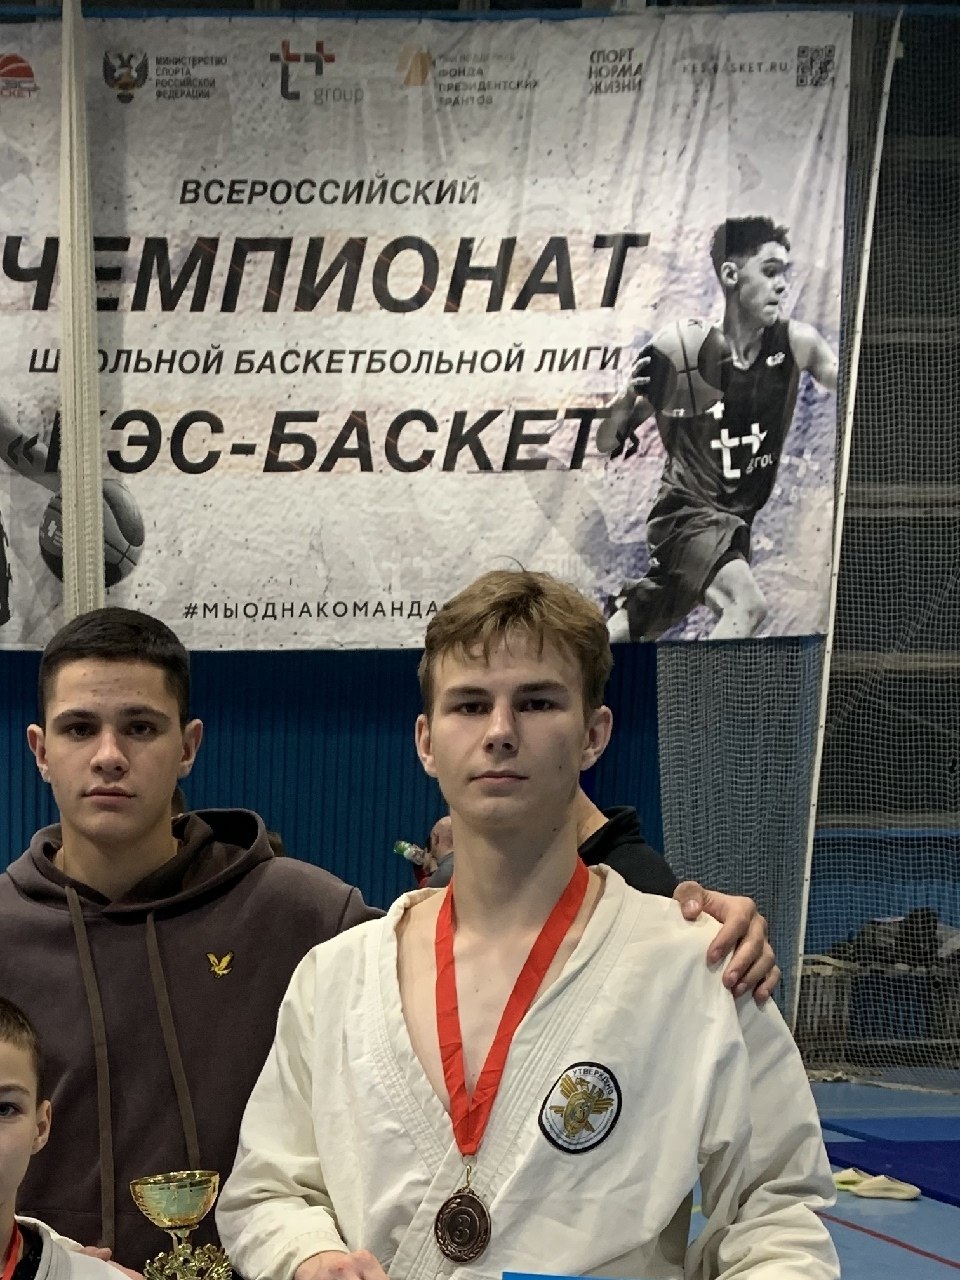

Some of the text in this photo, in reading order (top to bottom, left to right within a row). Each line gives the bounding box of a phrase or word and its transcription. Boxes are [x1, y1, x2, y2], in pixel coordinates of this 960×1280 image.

[155, 55, 228, 68] МИНИСТЕРСТВО
[589, 47, 635, 63] СПОРТ
[154, 67, 191, 78] СПОРТА
[438, 68, 484, 78] ФОНДА
[588, 62, 643, 80] НОРМА
[154, 78, 217, 90] РОССИЙСКОЙ
[589, 79, 642, 95] ЖИЗНИ
[155, 90, 212, 101] ФЕДЕРАЦИИ
[313, 86, 365, 106] group
[178, 177, 481, 206] ВСЕРОССИЙСКИЙ
[0, 231, 652, 314] ЧЕМПИОНАТ
[28, 339, 621, 375] ШЛЬНОЙ БАСКЕТБОЛЬНОЙ ЛИГИ
[183, 599, 439, 621] #МЫОДНАКОМАНДА
[455, 1214, 471, 1243] 3
